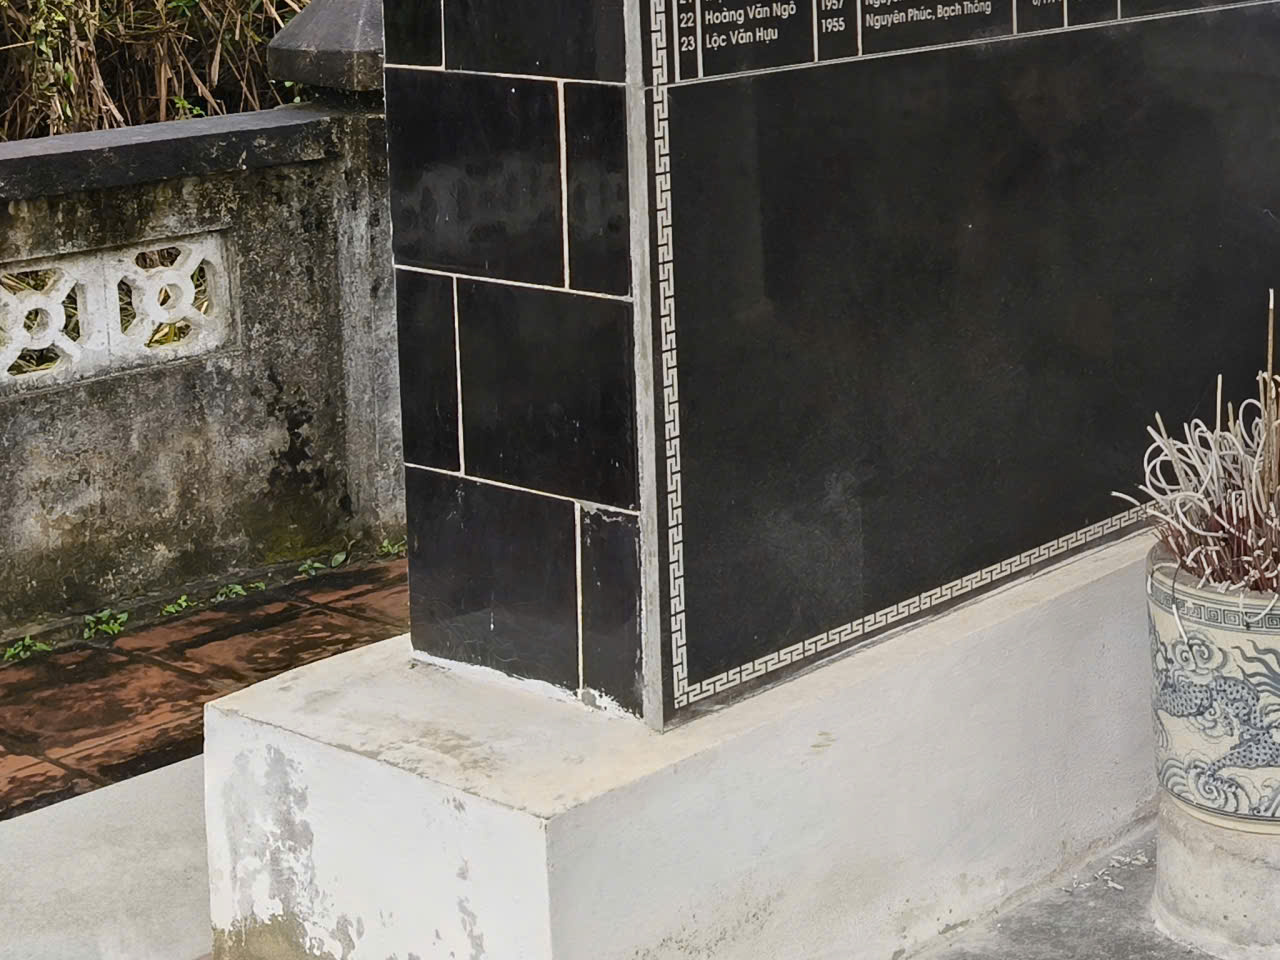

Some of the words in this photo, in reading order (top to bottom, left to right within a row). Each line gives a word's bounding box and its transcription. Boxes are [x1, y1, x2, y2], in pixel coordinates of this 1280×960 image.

[679, 11, 695, 28] 22
[704, 7, 745, 25] Hoàng
[746, 3, 771, 20] Văn
[865, 9, 906, 30] Nguyên
[907, 5, 936, 22] Phúc,
[936, 2, 962, 20] Bạch
[962, 0, 992, 15] Thông
[820, 16, 846, 33] 1955
[680, 35, 696, 52] 23
[705, 32, 728, 51] Lộc
[729, 28, 754, 45] Văn
